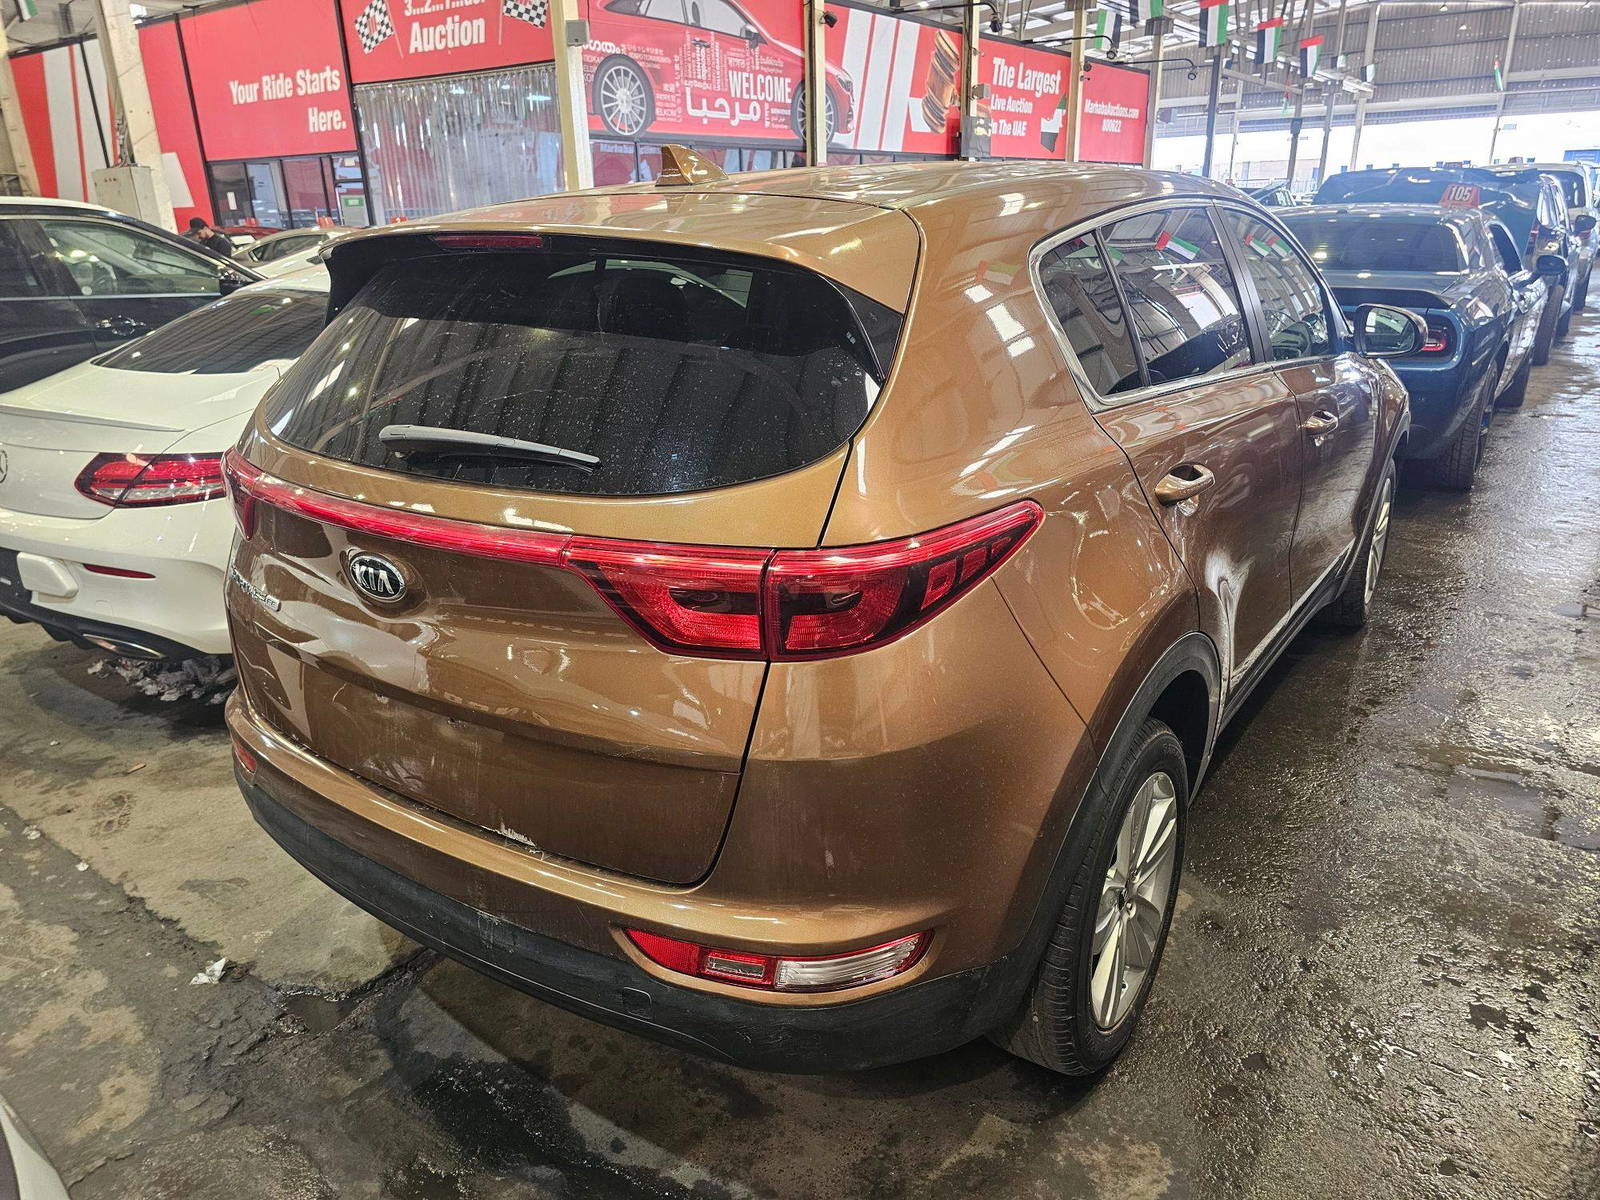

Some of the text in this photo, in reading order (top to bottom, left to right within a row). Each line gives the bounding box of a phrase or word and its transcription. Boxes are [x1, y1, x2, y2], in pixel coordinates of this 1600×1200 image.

[409, 15, 485, 54] Auction
[229, 65, 341, 105] Your Ride Starts
[728, 70, 792, 104] WELCOME
[992, 57, 1062, 98] The Largest
[308, 107, 347, 133] Here.
[685, 86, 761, 126] مرحبا
[990, 94, 1033, 114] Live Auction
[998, 119, 1012, 135] The
[1012, 120, 1027, 136] UAE
[1448, 185, 1473, 202] 105
[352, 563, 394, 594] KIA
